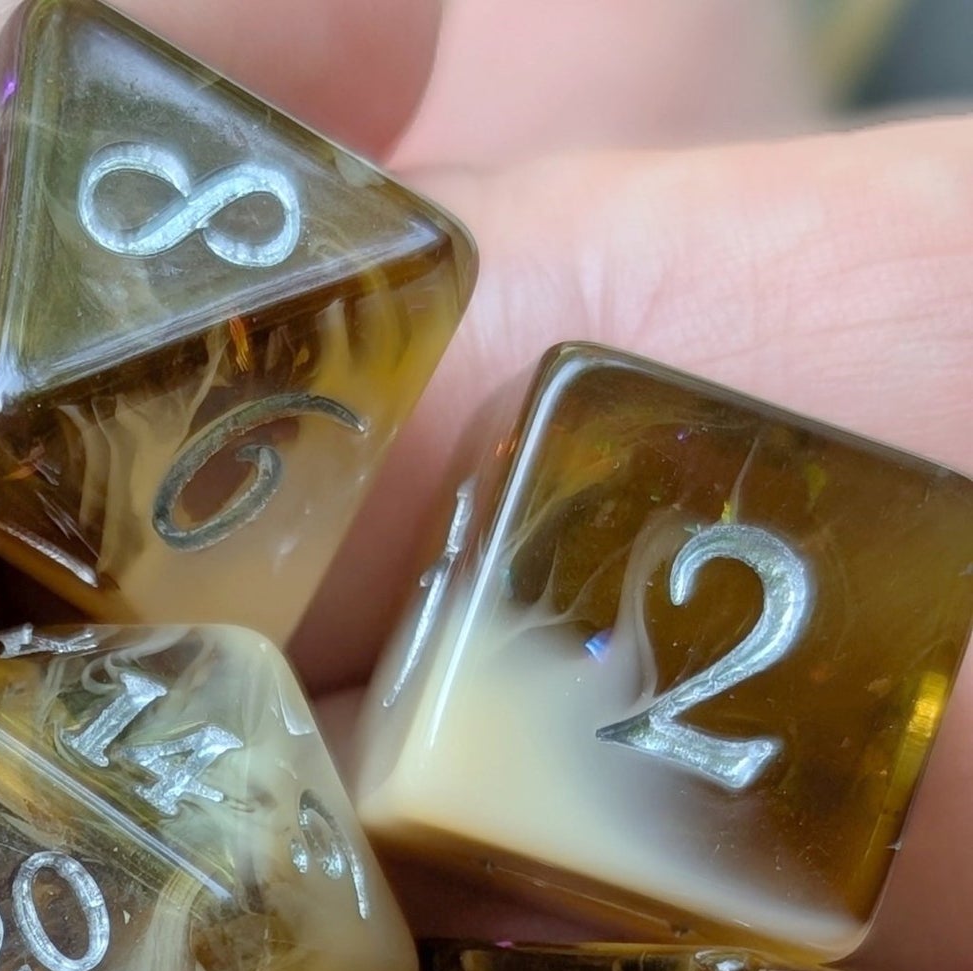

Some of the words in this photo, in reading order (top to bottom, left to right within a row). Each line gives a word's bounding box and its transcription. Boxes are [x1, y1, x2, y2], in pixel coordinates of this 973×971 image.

[77, 141, 302, 268] 8
[595, 523, 810, 790] 2
[60, 672, 244, 817] 14
